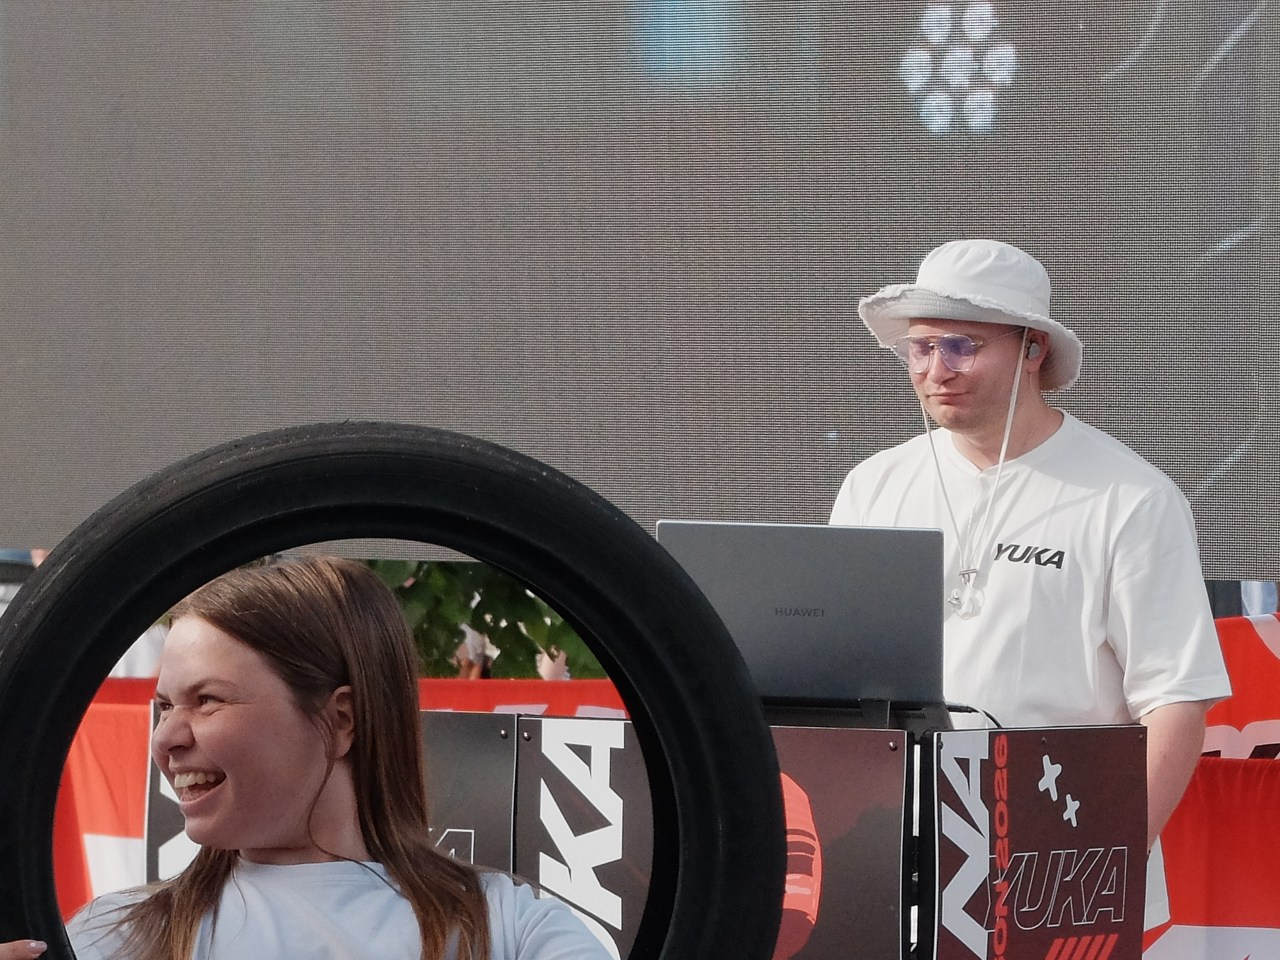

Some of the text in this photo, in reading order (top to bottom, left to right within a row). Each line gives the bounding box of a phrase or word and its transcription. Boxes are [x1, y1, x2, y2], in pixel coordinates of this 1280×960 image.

[994, 543, 1065, 569] YUKA
[775, 607, 825, 617] HUAWEI
[994, 734, 1009, 868] 2026
[984, 846, 1128, 931] YUKA
